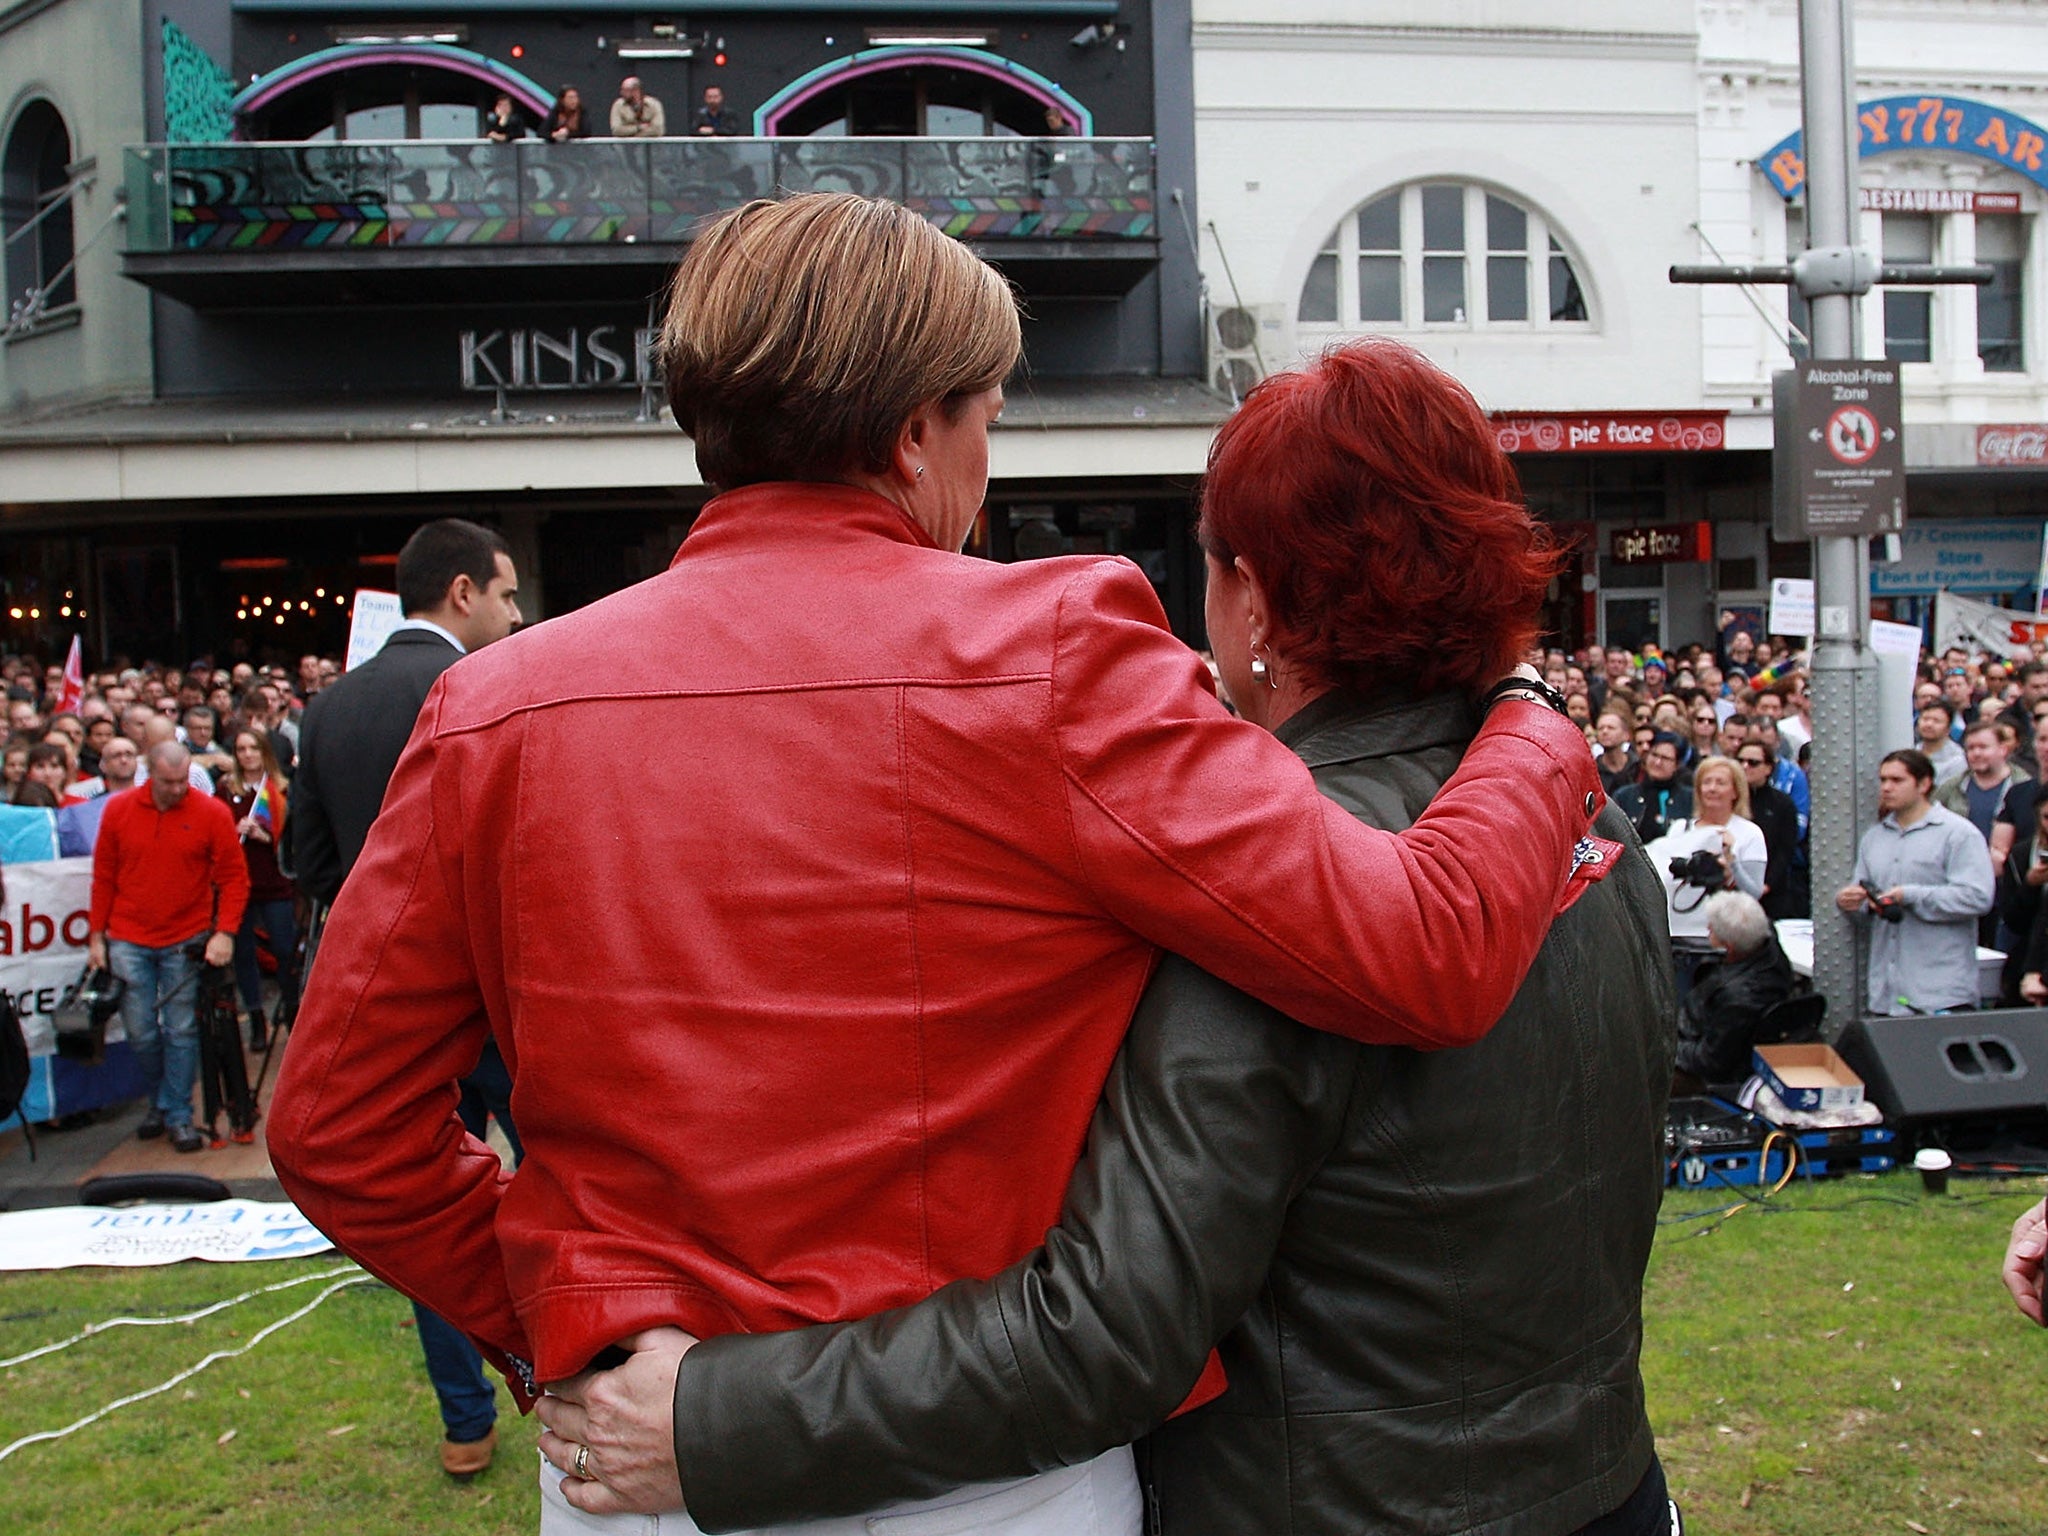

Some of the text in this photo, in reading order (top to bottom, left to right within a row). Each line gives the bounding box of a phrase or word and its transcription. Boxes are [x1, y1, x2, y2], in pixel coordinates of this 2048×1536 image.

[1898, 98, 1965, 144] 777
[1860, 189, 1973, 211] RESTAURANT
[1807, 368, 1894, 385] Alcohol-Free
[1832, 385, 1869, 401] Zone
[1569, 418, 1654, 449] pie face
[1625, 528, 1681, 562] pie face
[1937, 549, 1984, 565] Store
[1916, 570, 1930, 583] of
[360, 597, 394, 613] Team
